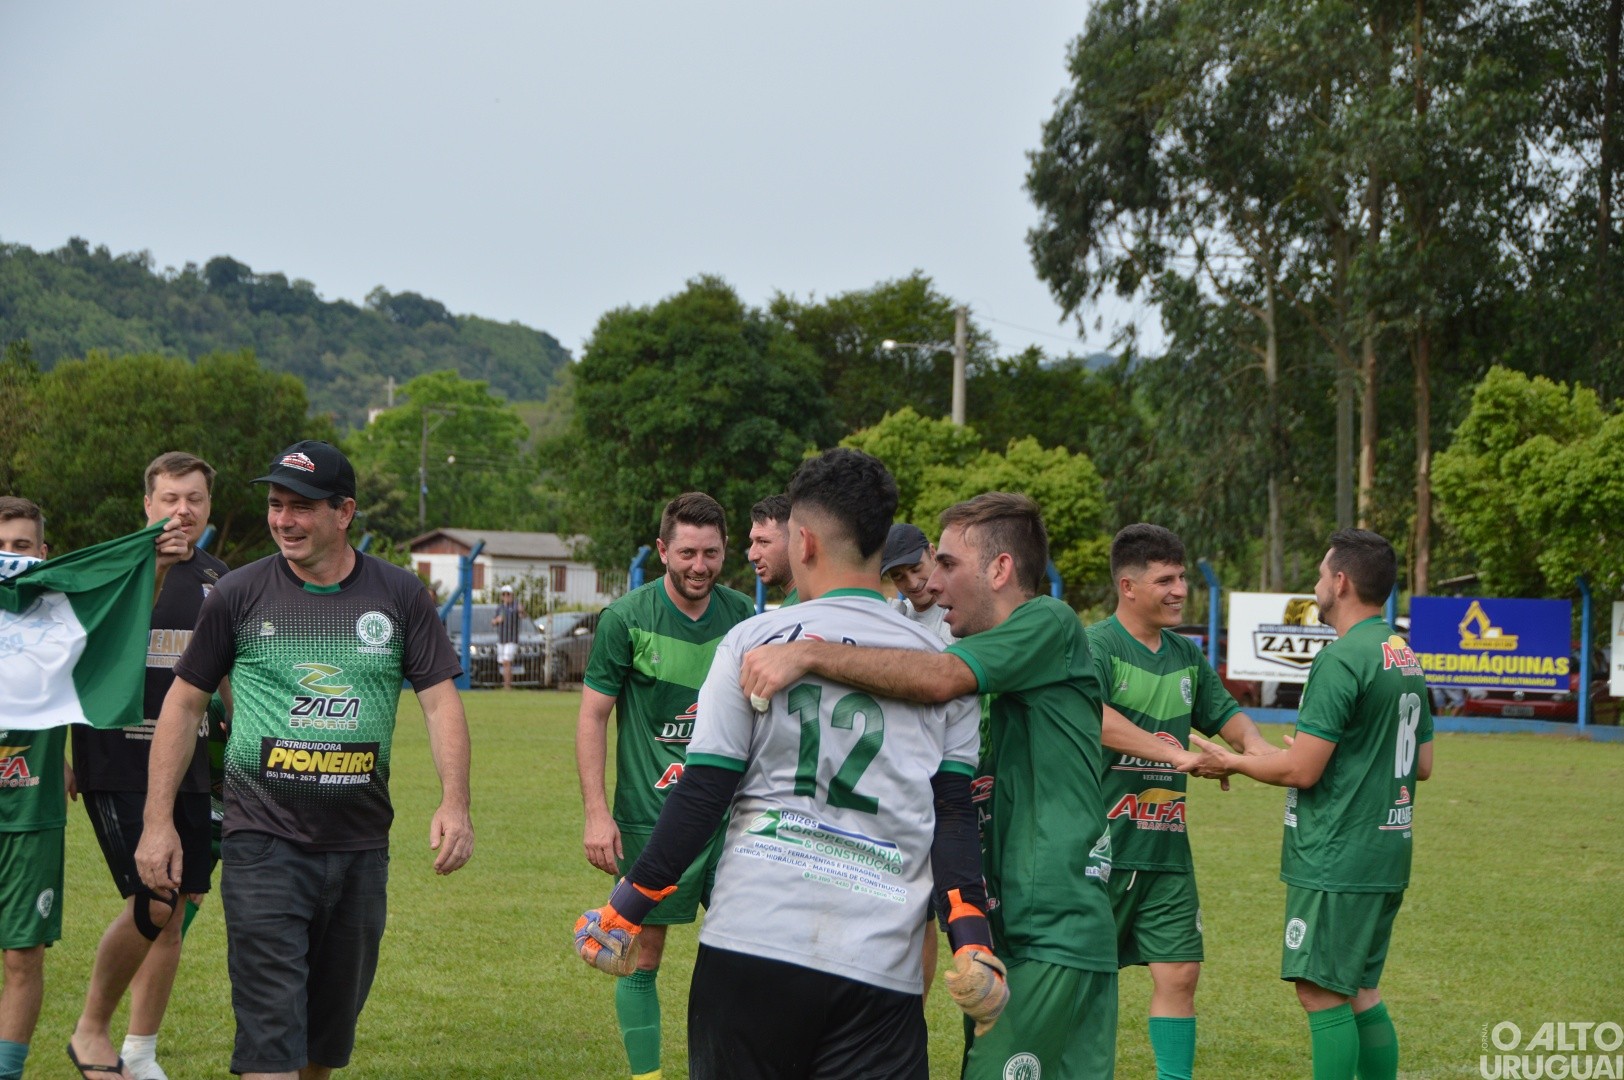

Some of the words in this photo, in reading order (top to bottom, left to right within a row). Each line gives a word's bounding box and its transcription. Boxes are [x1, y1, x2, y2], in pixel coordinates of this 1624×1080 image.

[290, 718, 358, 730] SPORTS
[275, 739, 342, 751] DISTRIBUIDORA
[788, 683, 884, 815] 12
[267, 748, 375, 773] PIONEIRO
[266, 770, 279, 779] (55)
[280, 772, 295, 780] 3744
[300, 774, 317, 782] 2675
[319, 773, 371, 785] BATERIAS
[781, 810, 818, 828] Raízes
[1107, 794, 1186, 823] ALFA
[778, 822, 903, 864] AGROPECUÁRIA
[754, 842, 782, 853] RAÇÕES
[788, 850, 836, 867] FERRAMENTAS
[842, 863, 881, 880] FERRAGENS
[804, 840, 812, 849] &
[815, 842, 901, 875] CONSTRUÇÃO
[766, 853, 807, 868] HIDRÁULICA
[813, 865, 848, 878] MATERIAIS
[849, 872, 858, 881] DE
[858, 876, 906, 895] CONSTRUÇÃO
